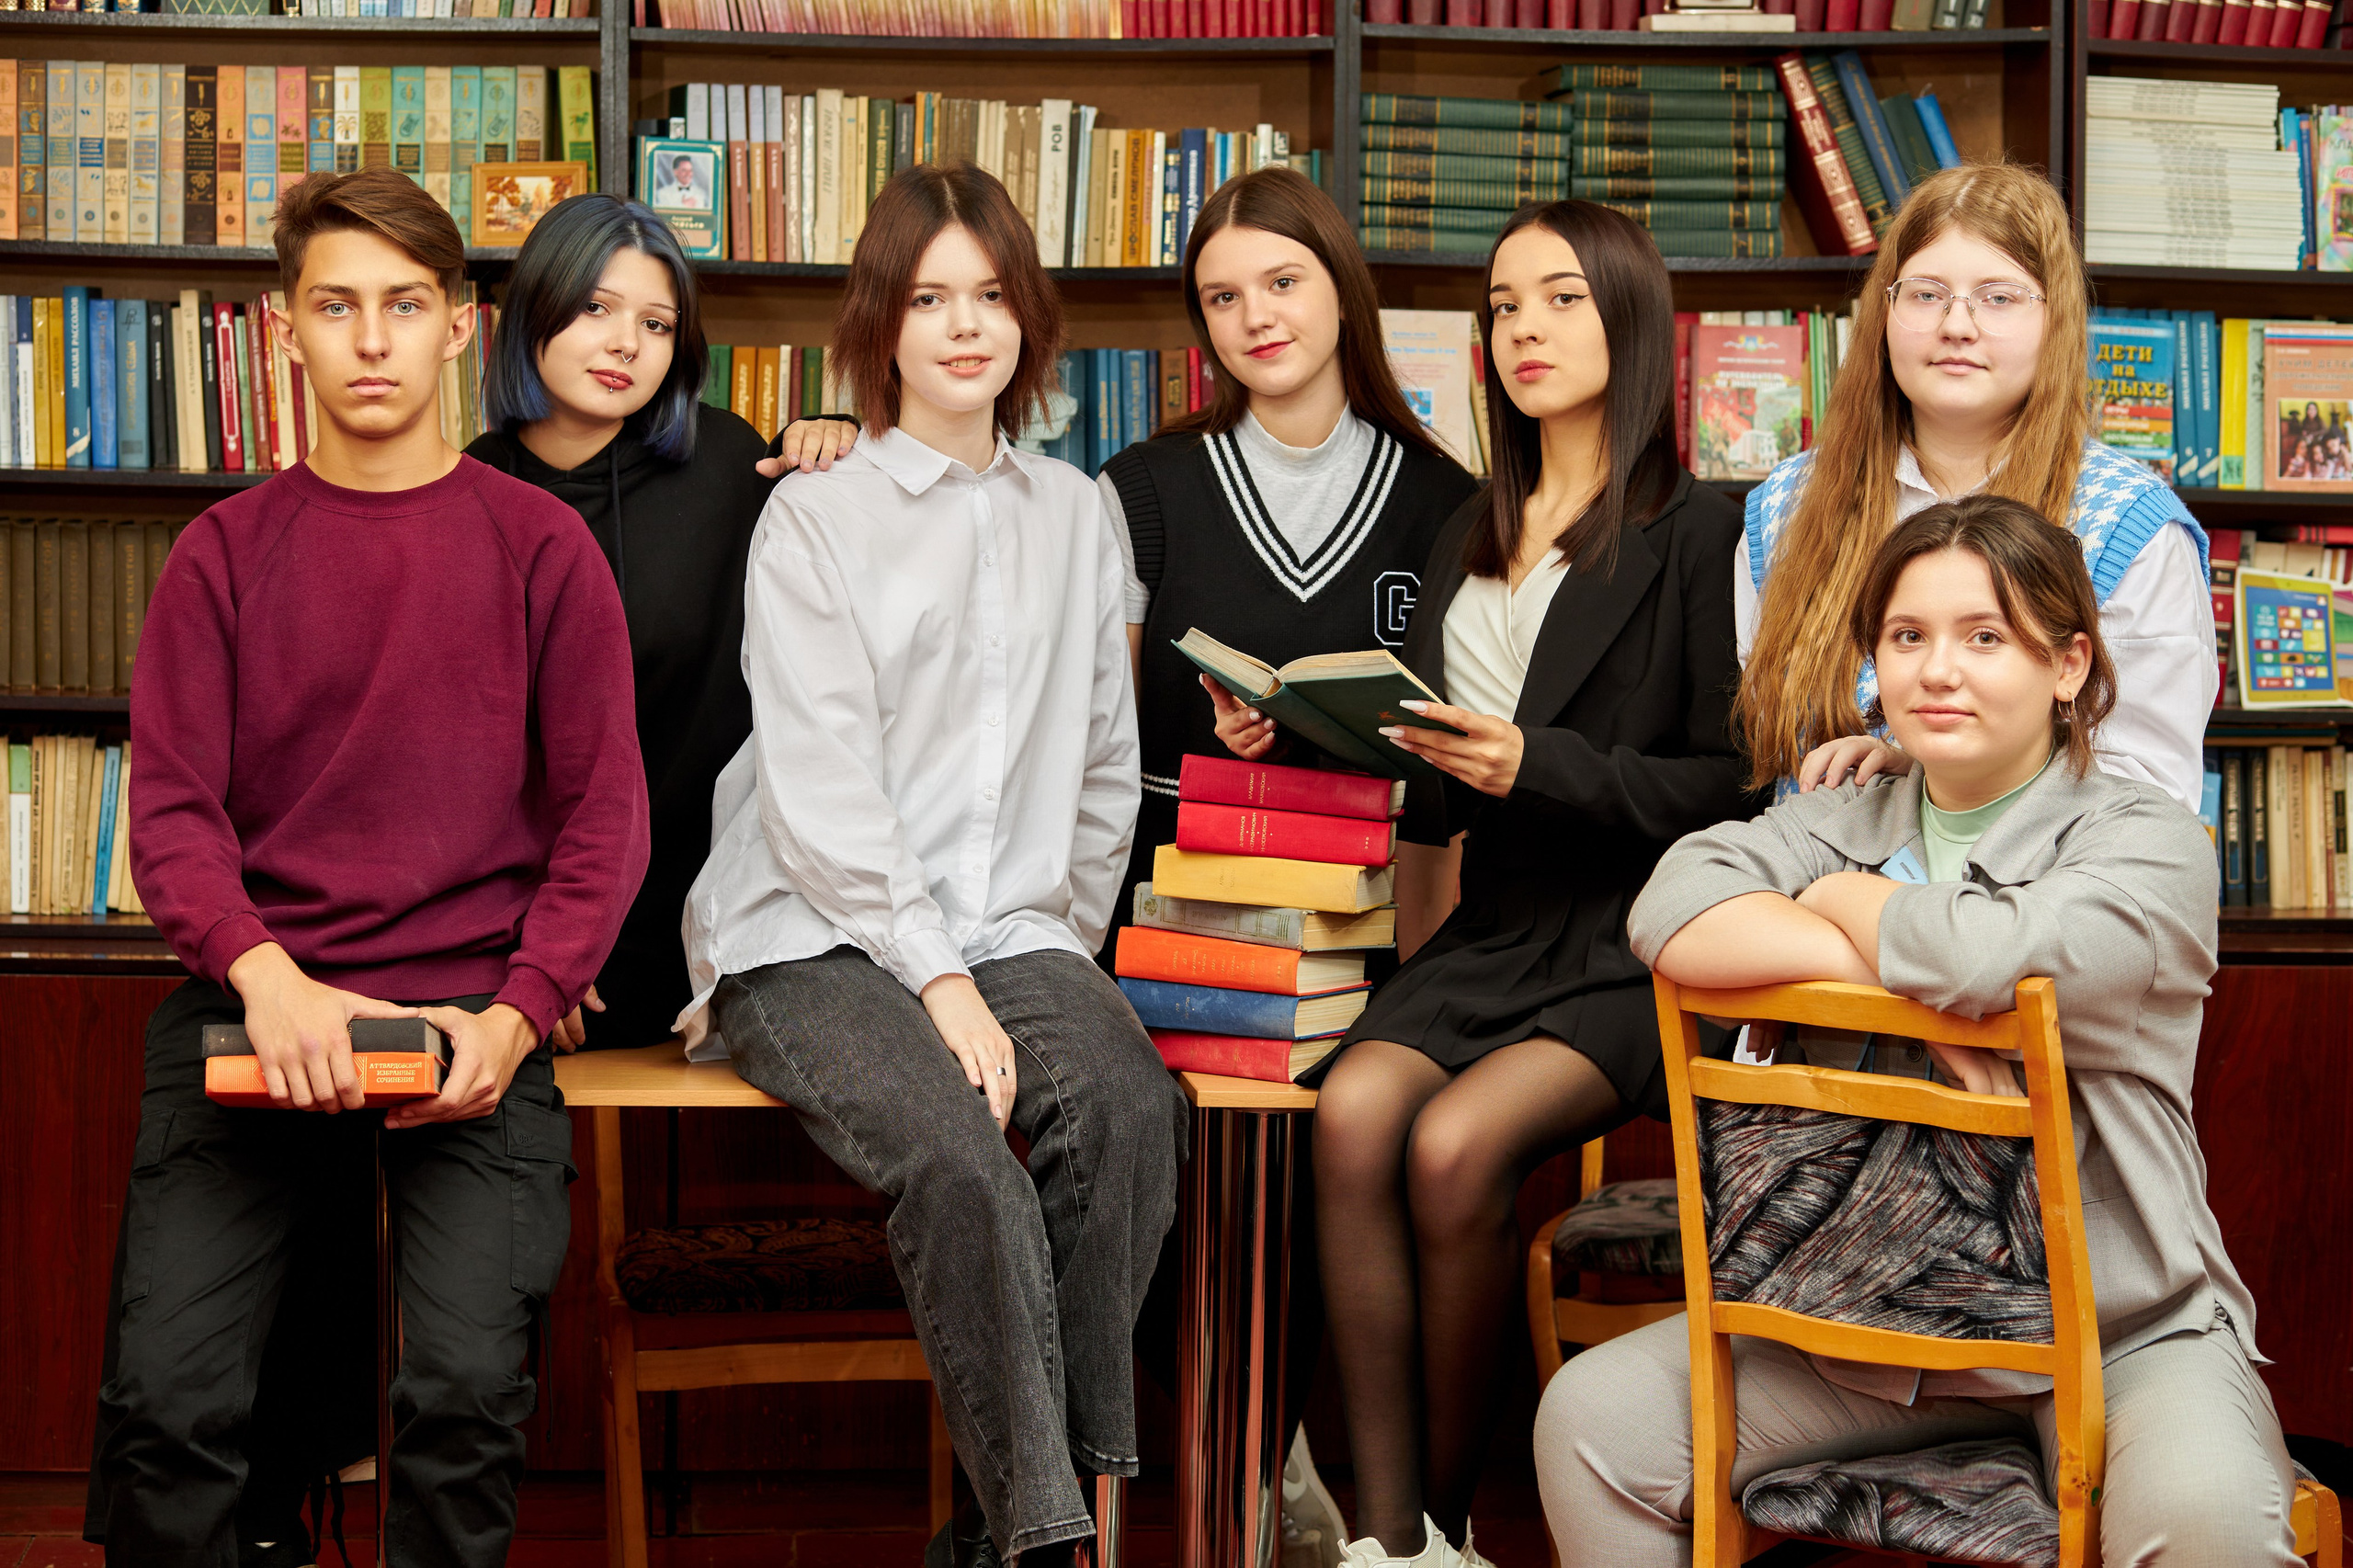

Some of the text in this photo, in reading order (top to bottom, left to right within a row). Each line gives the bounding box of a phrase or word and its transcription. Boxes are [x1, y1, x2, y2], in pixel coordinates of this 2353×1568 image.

[70, 296, 80, 389] МИХАИЛ РАССОЛОВ
[2097, 344, 2154, 363] ДЕТИ
[2112, 364, 2135, 377] на
[1373, 571, 1421, 646] G
